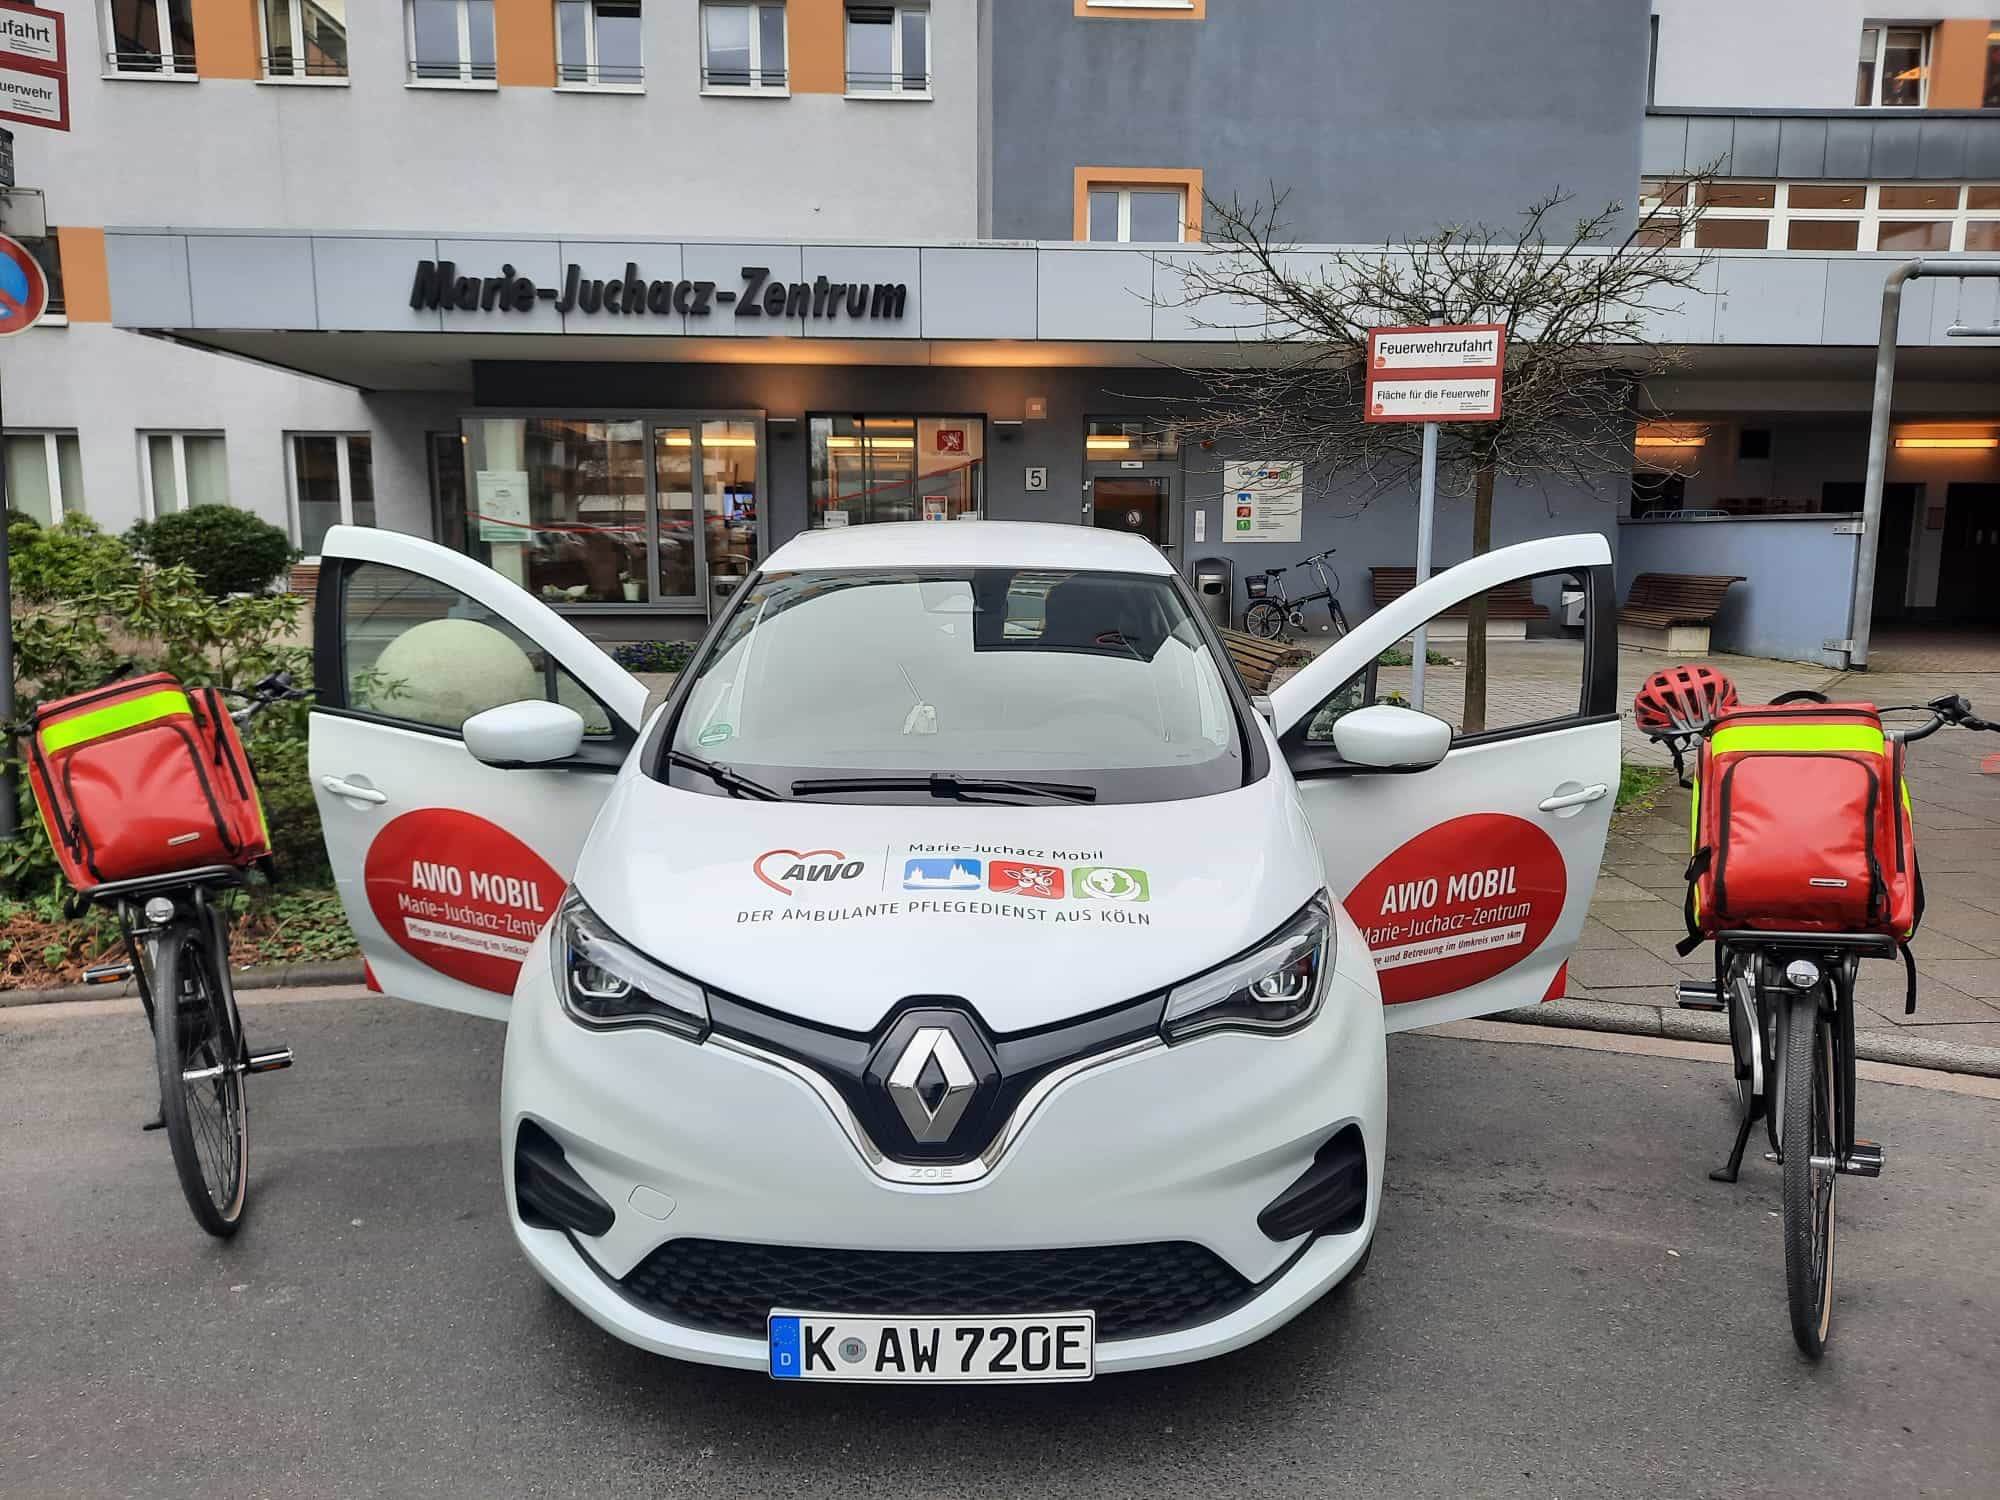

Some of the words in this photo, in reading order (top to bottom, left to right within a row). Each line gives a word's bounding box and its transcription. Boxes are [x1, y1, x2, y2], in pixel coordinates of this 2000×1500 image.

[410, 260, 907, 319] Marie-Juchacz-Zentrum
[1380, 339, 1493, 355] Feuerwehrzufahrt
[1377, 390, 1407, 400] Fläche
[1409, 389, 1422, 399] für
[1424, 388, 1438, 399] die
[1440, 388, 1490, 399] Feuerwehr
[1030, 470, 1042, 487] 5
[909, 843, 1044, 858] Marie-Juchacz
[1052, 850, 1104, 861] Mobil
[781, 861, 864, 881] AWO
[412, 860, 463, 896] AWO
[469, 870, 544, 912] MOBIL
[1380, 878, 1438, 915] AWO
[1446, 866, 1516, 904] MOBIL
[398, 892, 543, 937] Marie-Juchacz-Zentr
[737, 909, 774, 923] DER
[782, 902, 899, 922] AMBULANTE
[909, 901, 1047, 921] PFLEGEDIENST
[1055, 909, 1092, 923] AUS
[1101, 909, 1150, 925] KÖLN
[1359, 902, 1531, 945] Marie-Juchacz-Zentrum
[1384, 951, 1401, 963] und
[1403, 945, 1444, 959] Betreuung
[1445, 942, 1456, 952] im
[1458, 937, 1489, 949] Umkreis
[1490, 933, 1505, 943] von
[909, 1168, 953, 1178] ZOE
[780, 1352, 792, 1366] D
[804, 1326, 836, 1372] K
[874, 1327, 940, 1373] AW
[955, 1325, 1087, 1373] 720E
